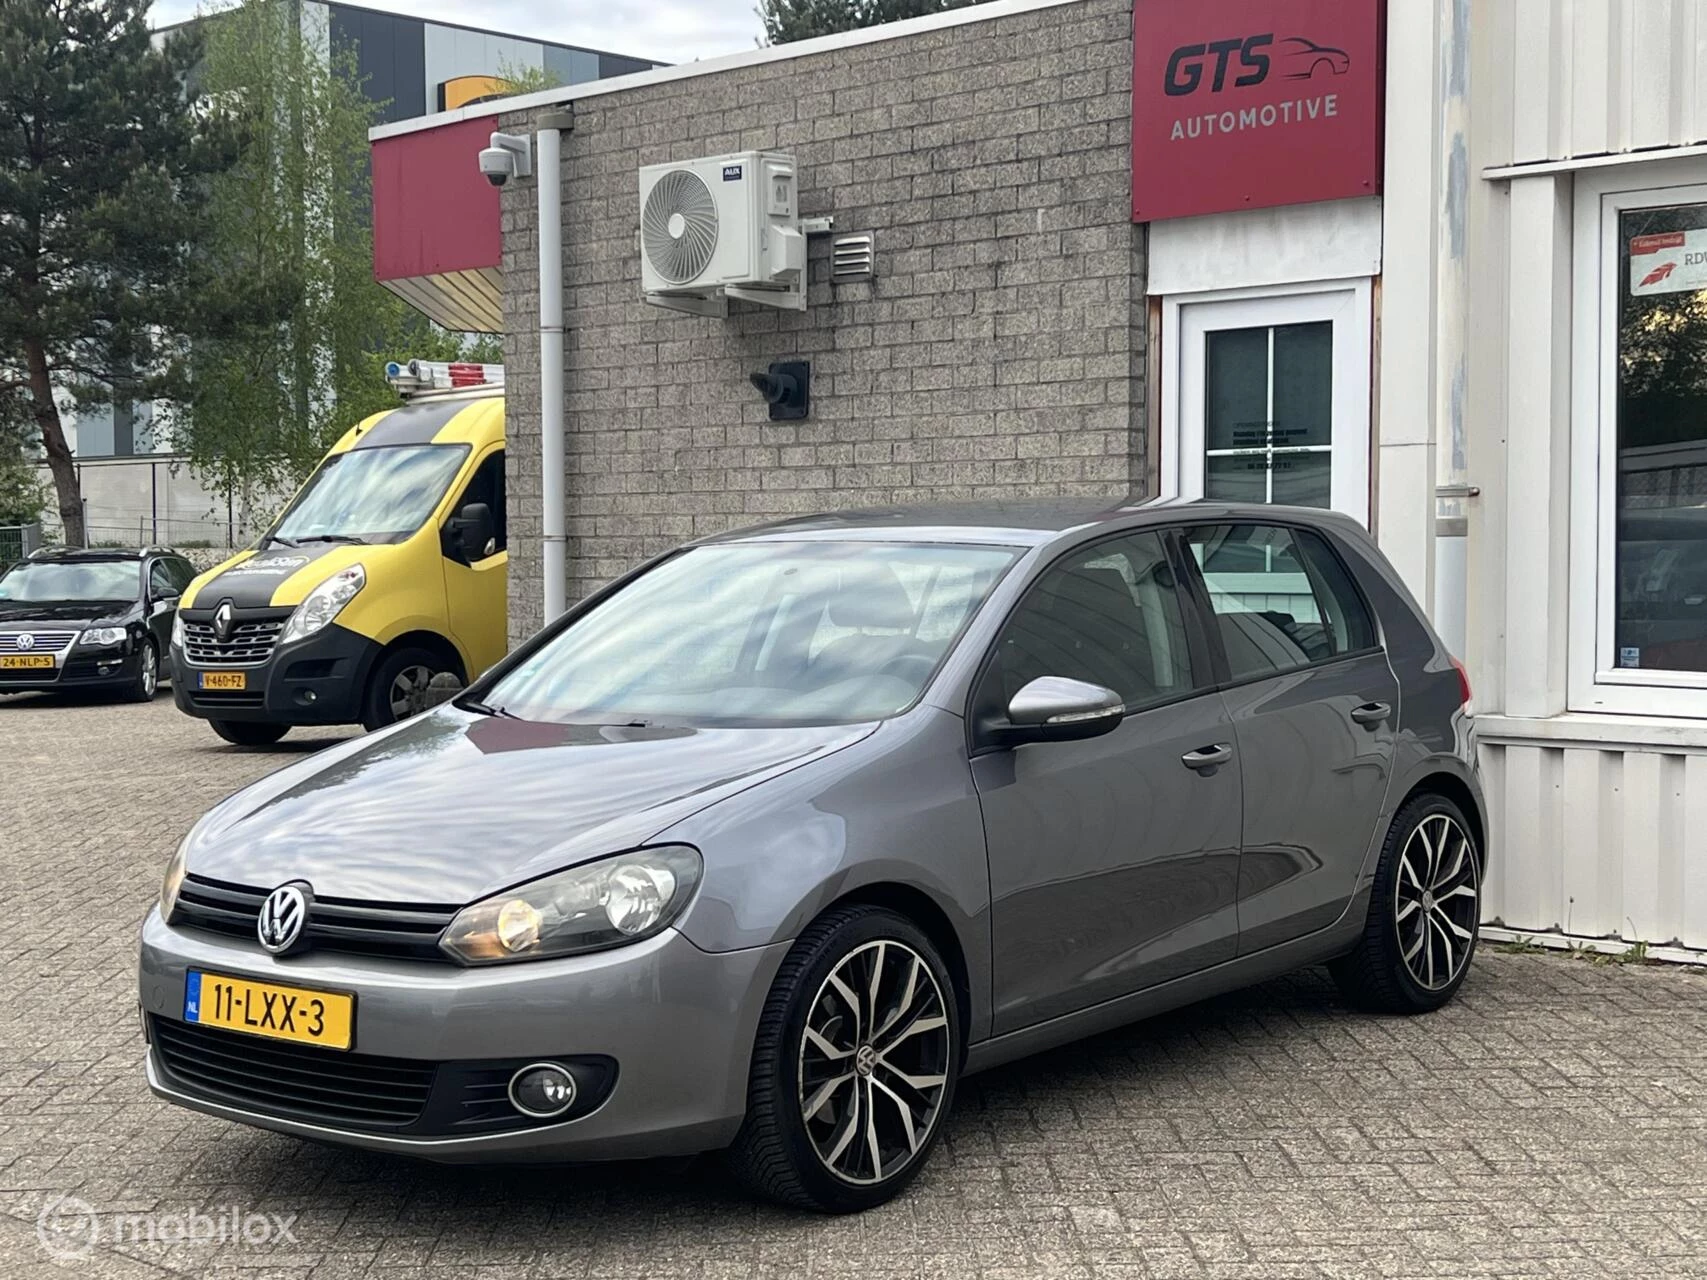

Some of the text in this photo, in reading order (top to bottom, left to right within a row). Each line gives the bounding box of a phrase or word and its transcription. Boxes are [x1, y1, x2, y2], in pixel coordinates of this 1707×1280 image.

[1164, 33, 1273, 96] GTS
[1171, 94, 1338, 140] AUTOMOTIVE
[725, 168, 740, 176] AUX
[1684, 251, 1707, 266] RD
[187, 1000, 198, 1014] NL
[214, 983, 325, 1037] 11-LXX-3
